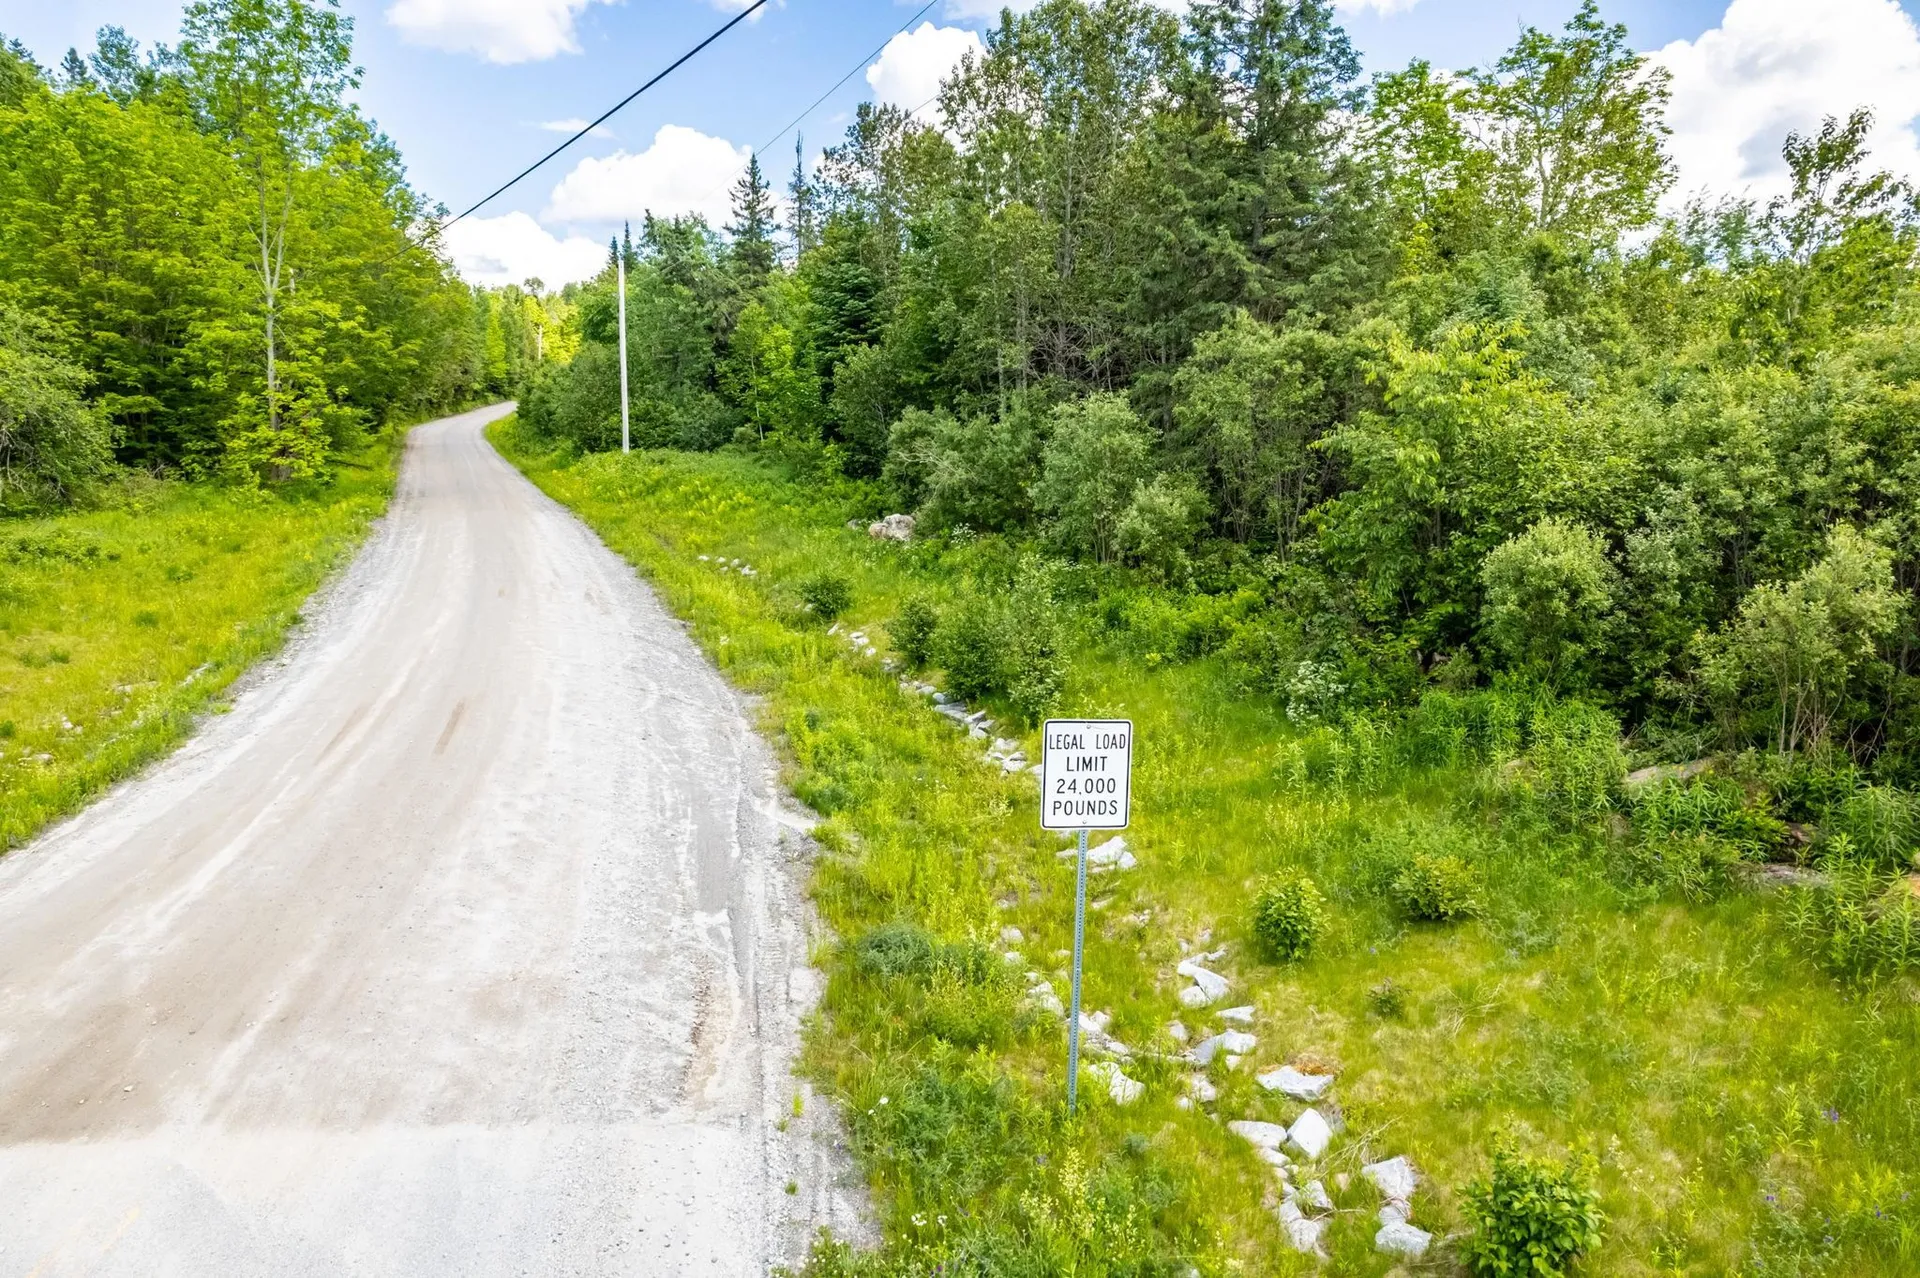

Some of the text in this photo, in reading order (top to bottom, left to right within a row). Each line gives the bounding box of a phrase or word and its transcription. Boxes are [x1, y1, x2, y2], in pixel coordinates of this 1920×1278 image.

[1049, 733, 1126, 750] LEGAL LOAD
[1066, 756, 1108, 772] LIMIT
[1056, 778, 1116, 795] 24,000
[1053, 800, 1118, 816] POUNDS
